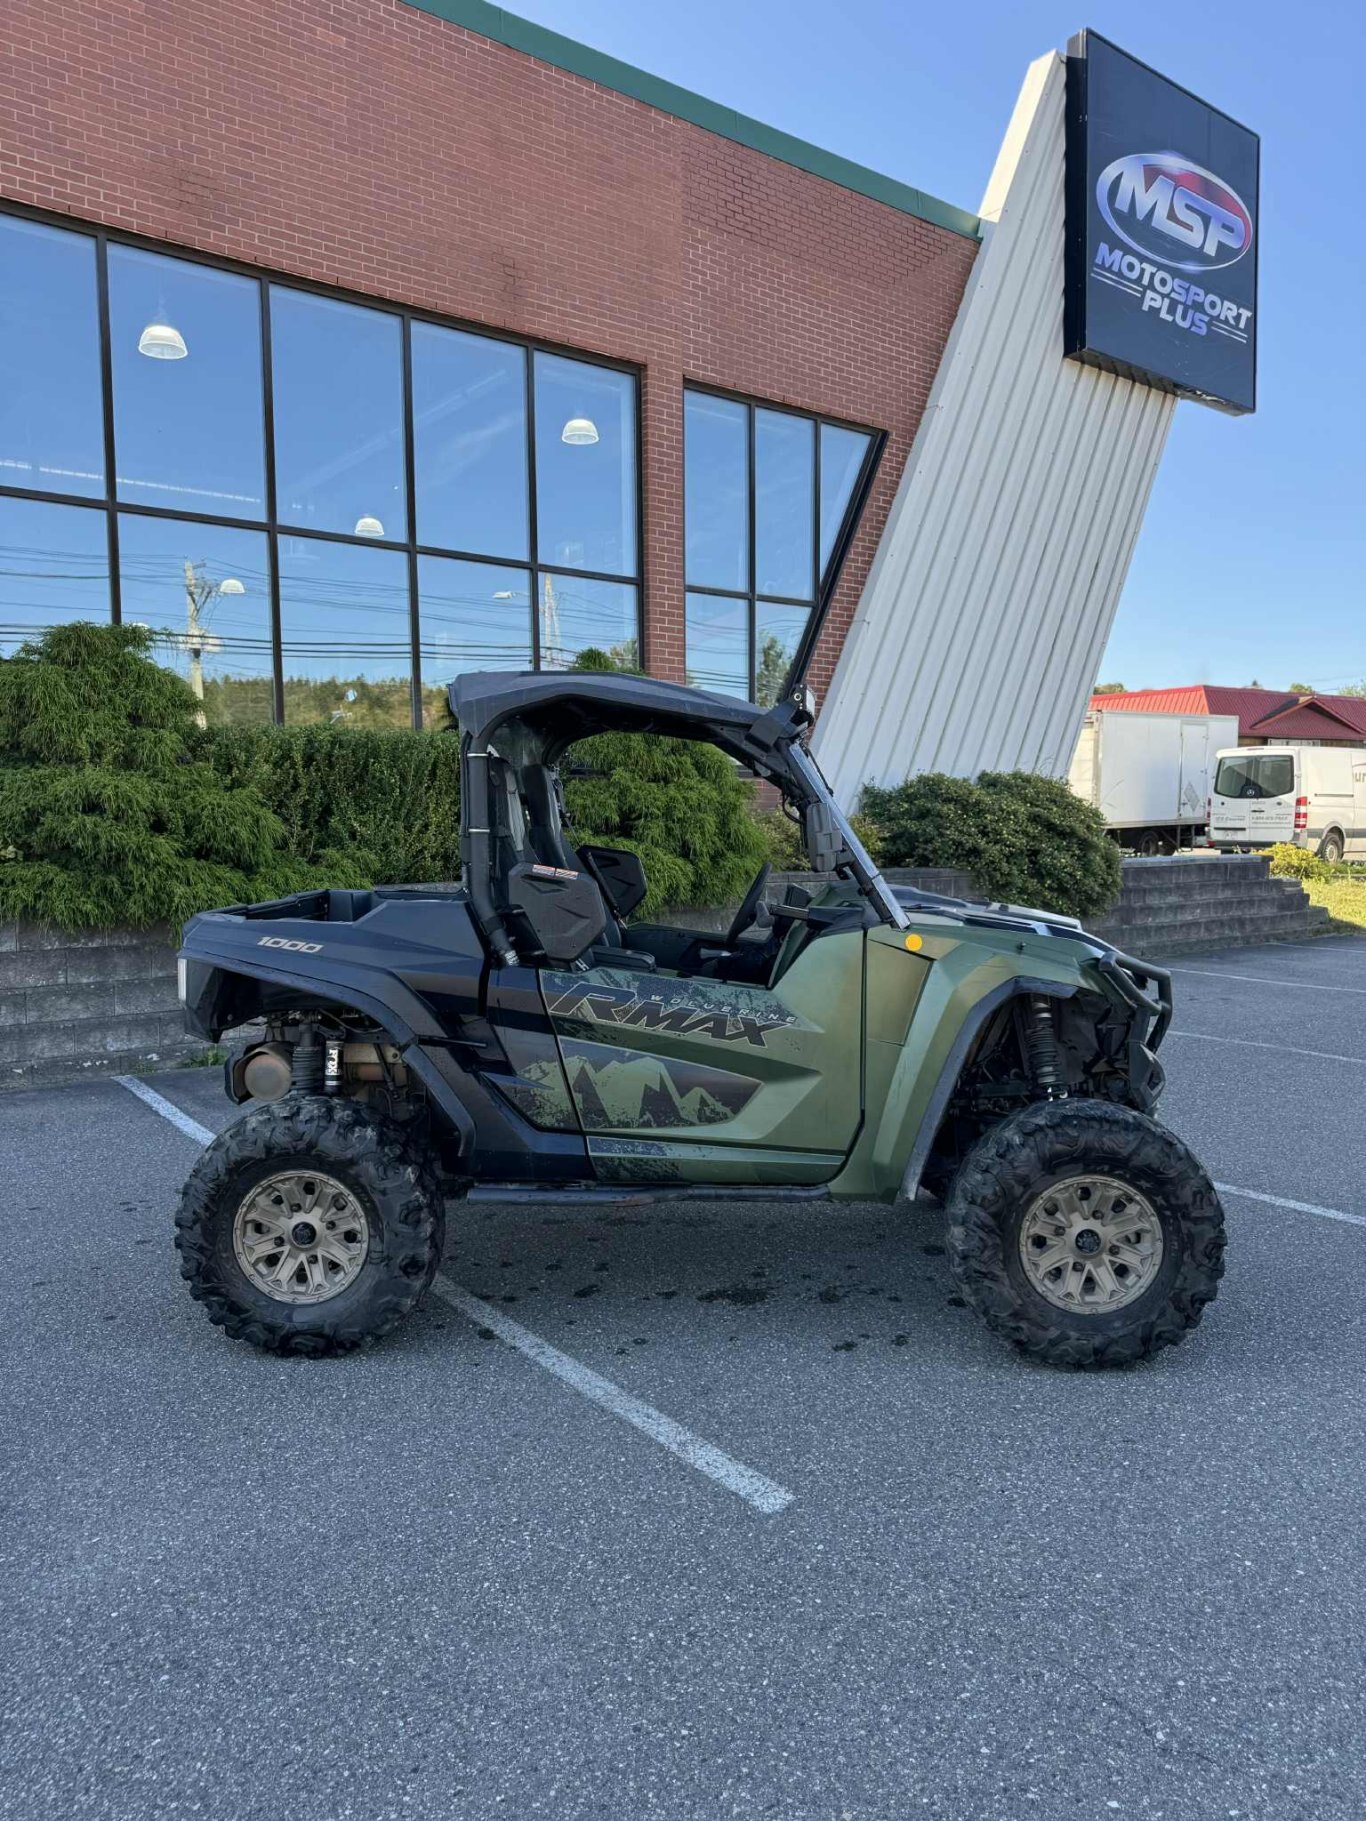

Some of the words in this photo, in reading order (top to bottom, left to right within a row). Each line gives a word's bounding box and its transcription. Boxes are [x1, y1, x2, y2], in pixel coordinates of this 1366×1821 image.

[1114, 160, 1246, 257] MSP
[1095, 242, 1252, 329] MOTOSPORT
[1141, 289, 1210, 336] PLUS
[256, 936, 324, 953] 1000
[549, 981, 792, 1048] RMAX
[650, 994, 797, 1023] WOLVERINE
